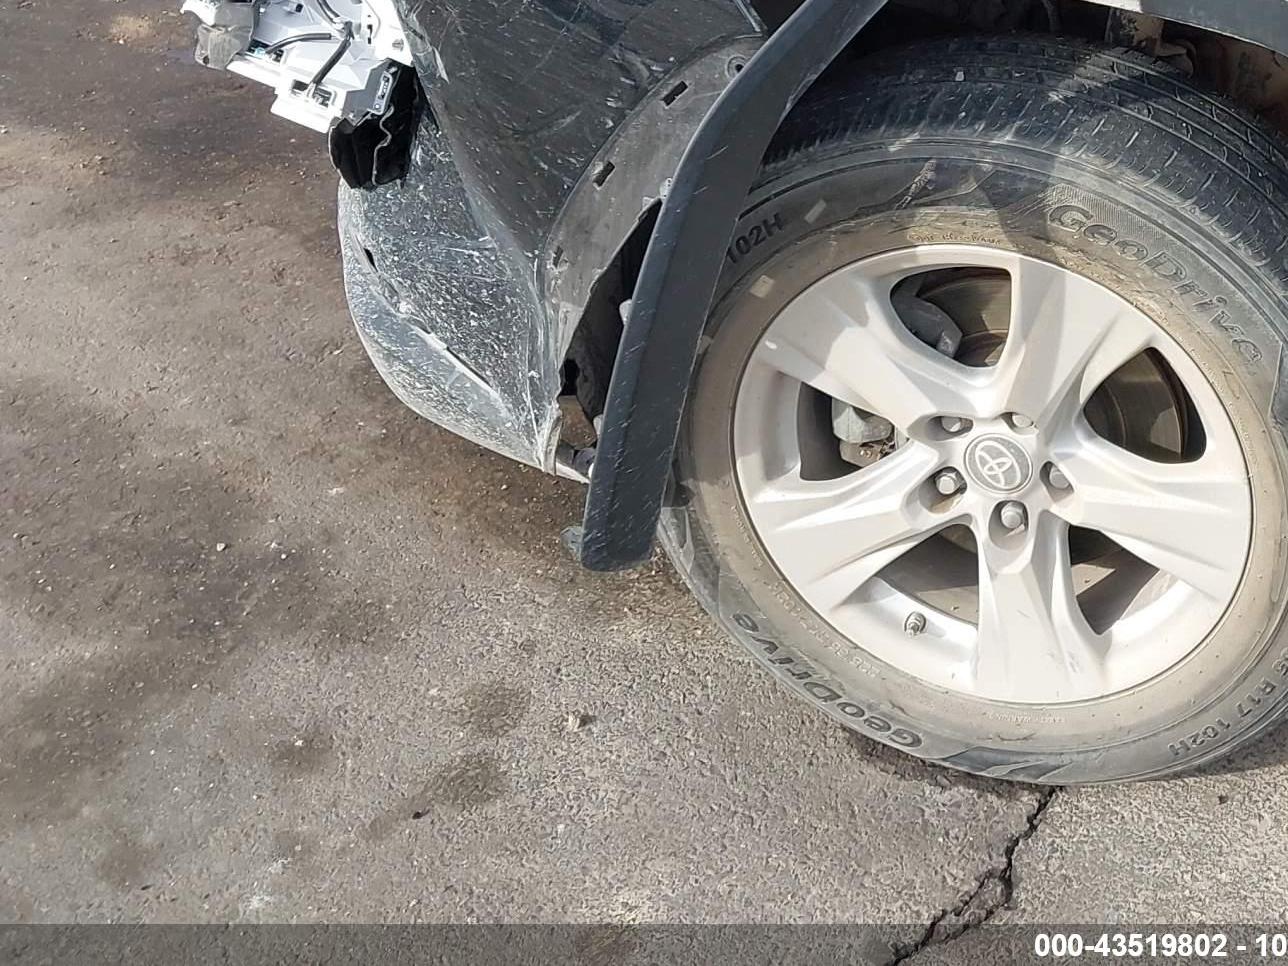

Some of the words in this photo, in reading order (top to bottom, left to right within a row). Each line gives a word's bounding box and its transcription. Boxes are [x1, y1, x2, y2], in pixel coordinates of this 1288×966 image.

[1049, 204, 1263, 364] GeoDrive
[732, 612, 923, 748] GeoDrive
[1235, 677, 1277, 718] R17
[1168, 718, 1231, 756] 102H
